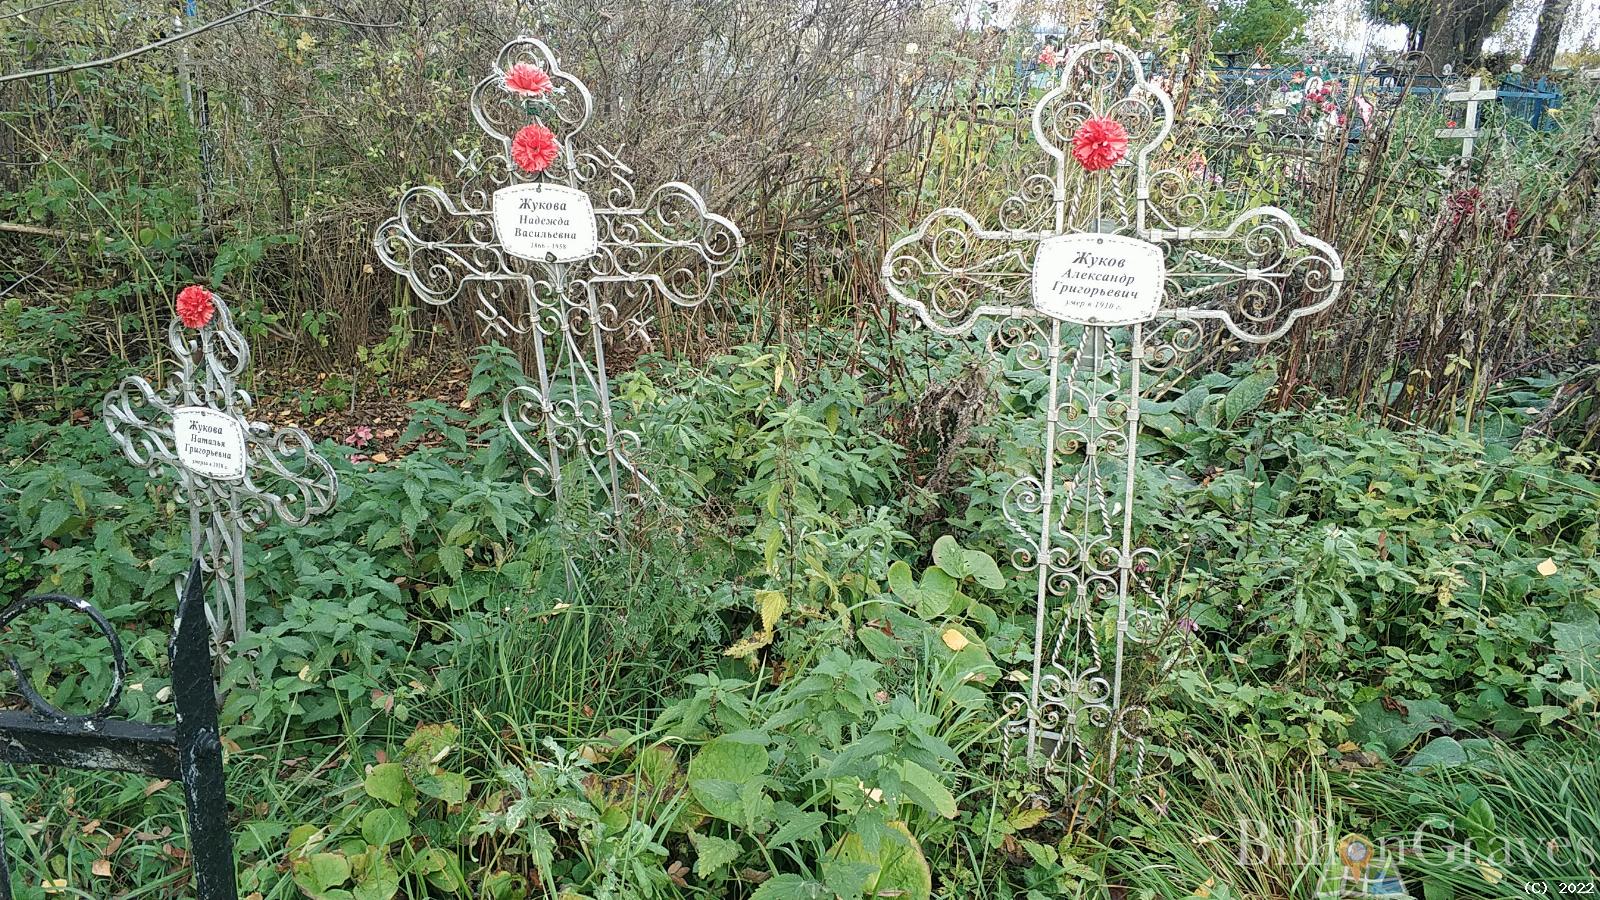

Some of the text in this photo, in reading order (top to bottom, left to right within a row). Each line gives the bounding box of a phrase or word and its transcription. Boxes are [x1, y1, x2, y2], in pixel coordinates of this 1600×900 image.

[519, 198, 567, 213] Жукова
[519, 215, 570, 226] Надежда
[515, 227, 577, 240] Васильевна
[1072, 251, 1126, 268] Жуков
[1061, 268, 1135, 286] Александр
[1052, 281, 1139, 299] Григорьевич
[1065, 299, 1085, 308] умер
[189, 420, 223, 435] Жукова
[190, 433, 226, 448] Наталья
[184, 443, 232, 460] Григорьевна
